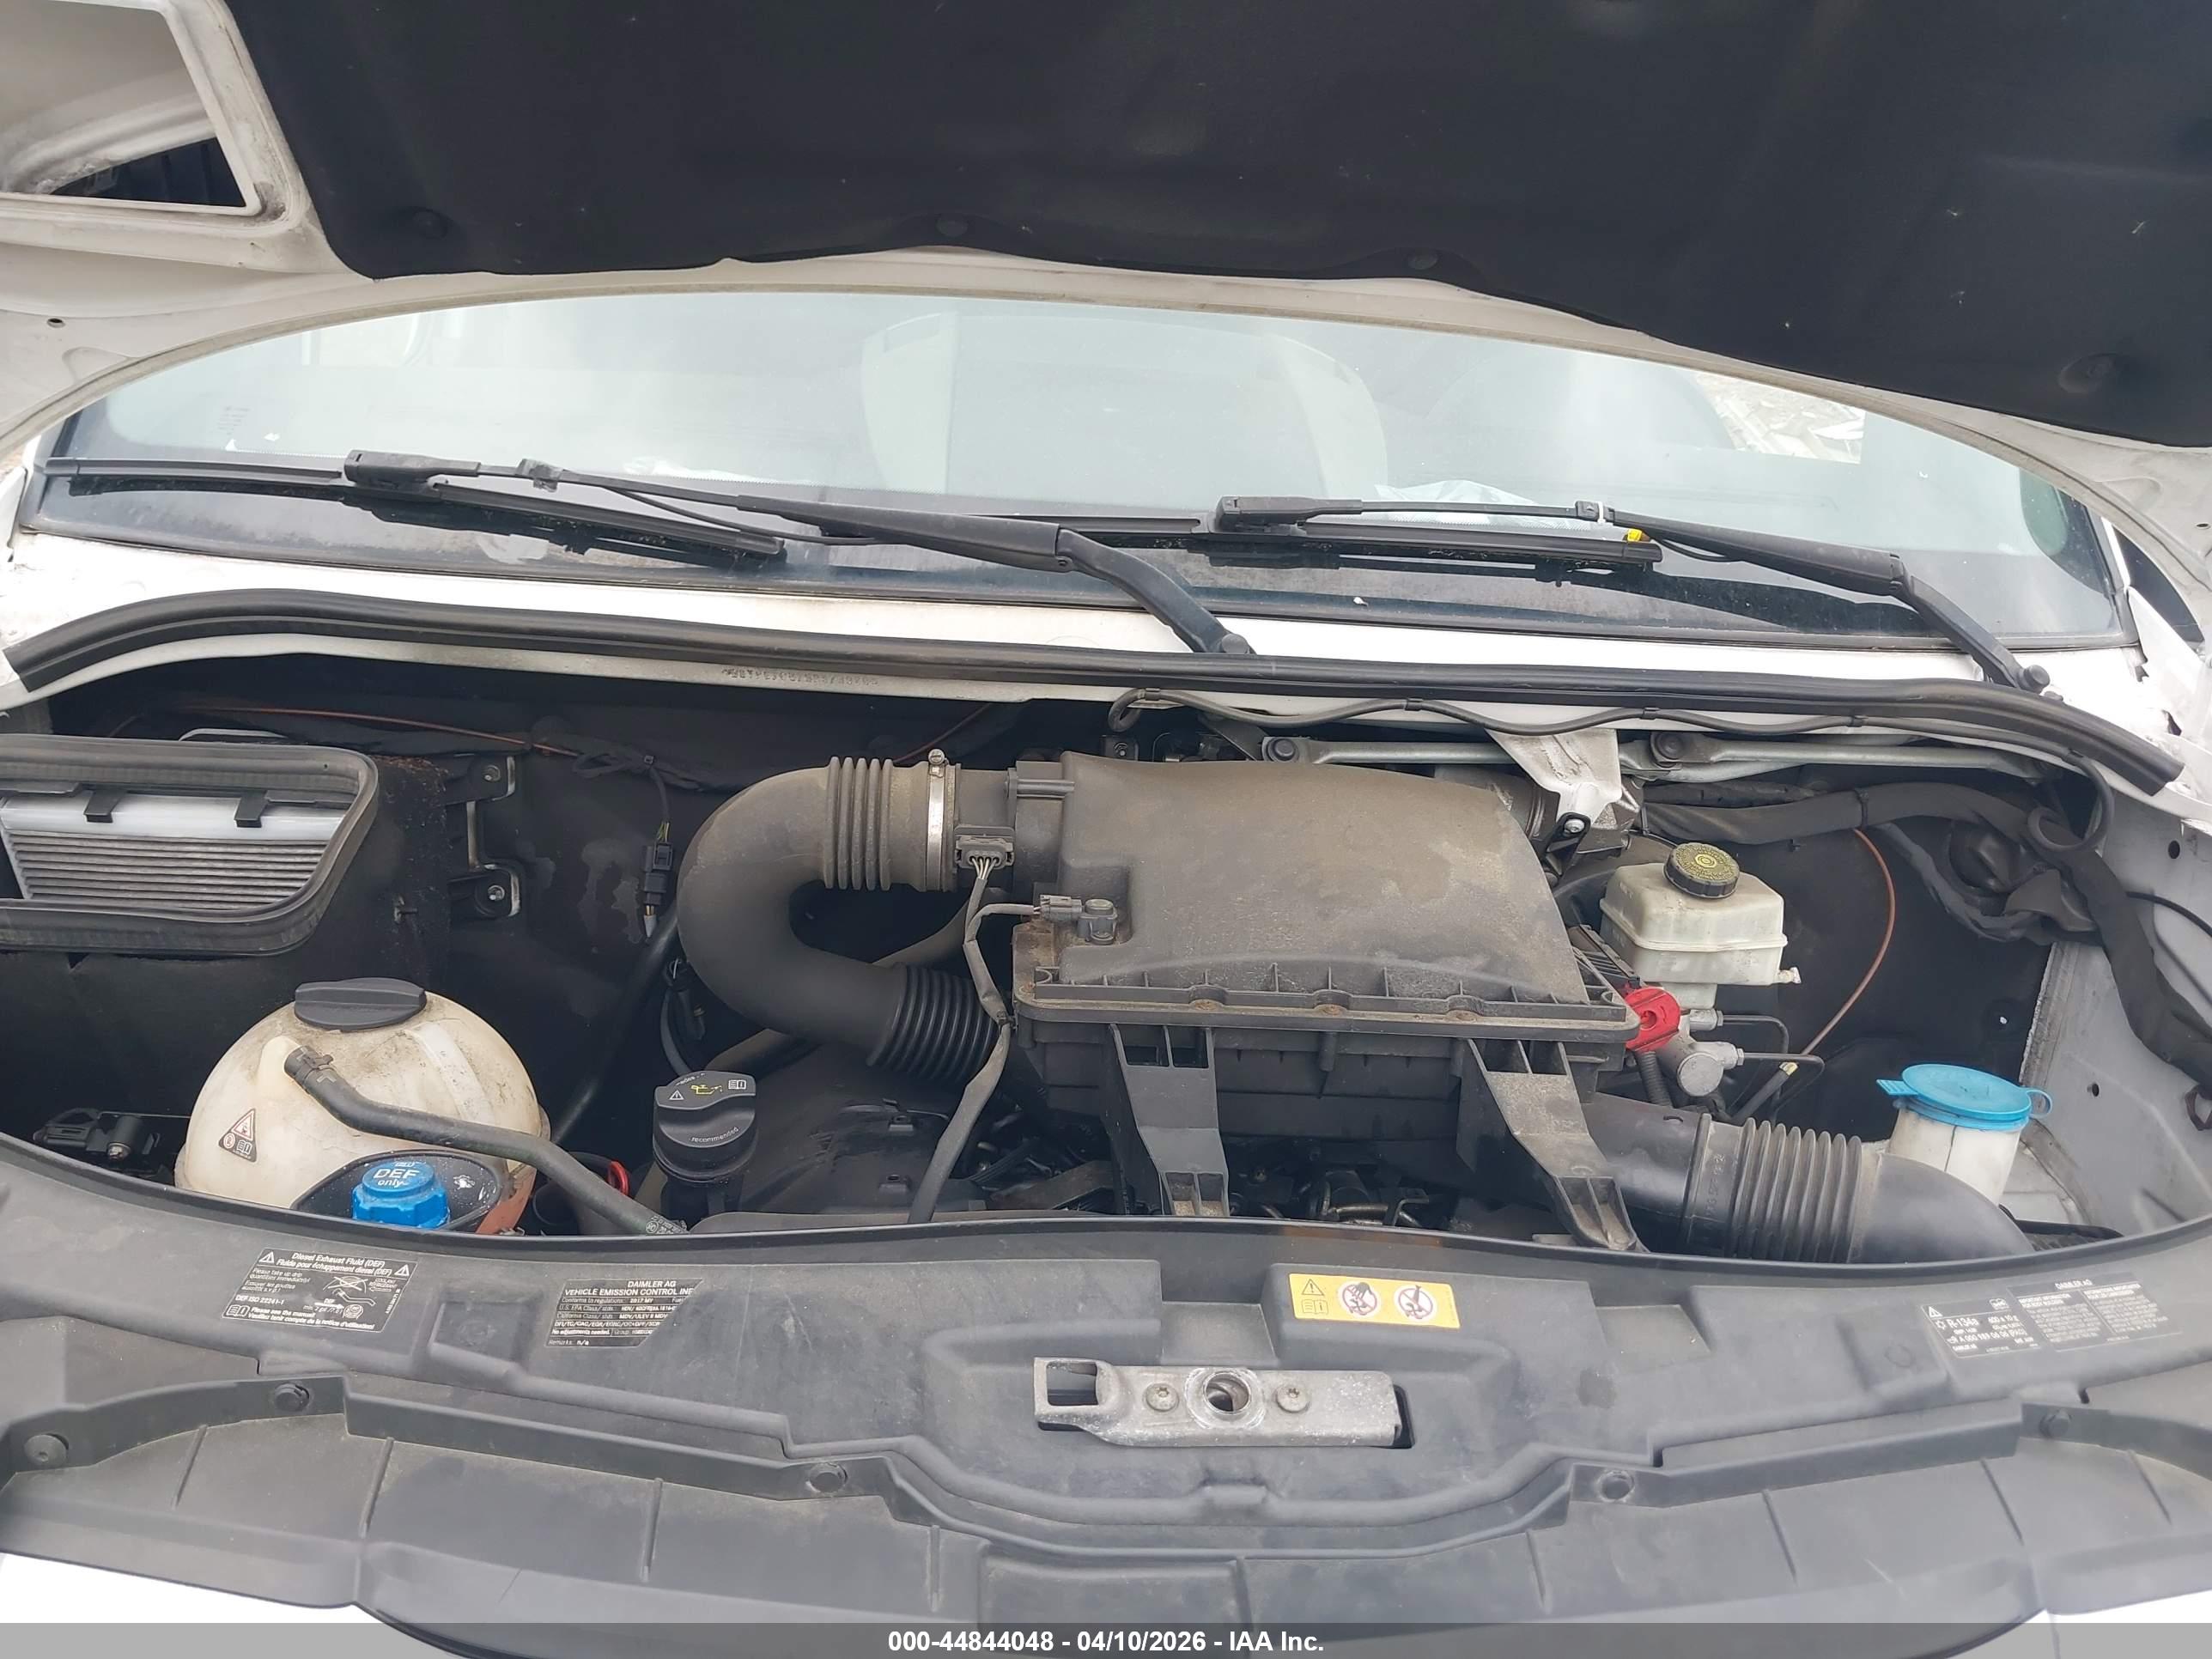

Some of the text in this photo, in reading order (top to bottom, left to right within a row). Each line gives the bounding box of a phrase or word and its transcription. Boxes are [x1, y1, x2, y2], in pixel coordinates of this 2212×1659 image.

[690, 1127, 739, 1143] recommended
[374, 1169, 420, 1179] DEF
[378, 1179, 402, 1188] only
[291, 1252, 386, 1269] Diesel Exhaust Fluid (DEF)
